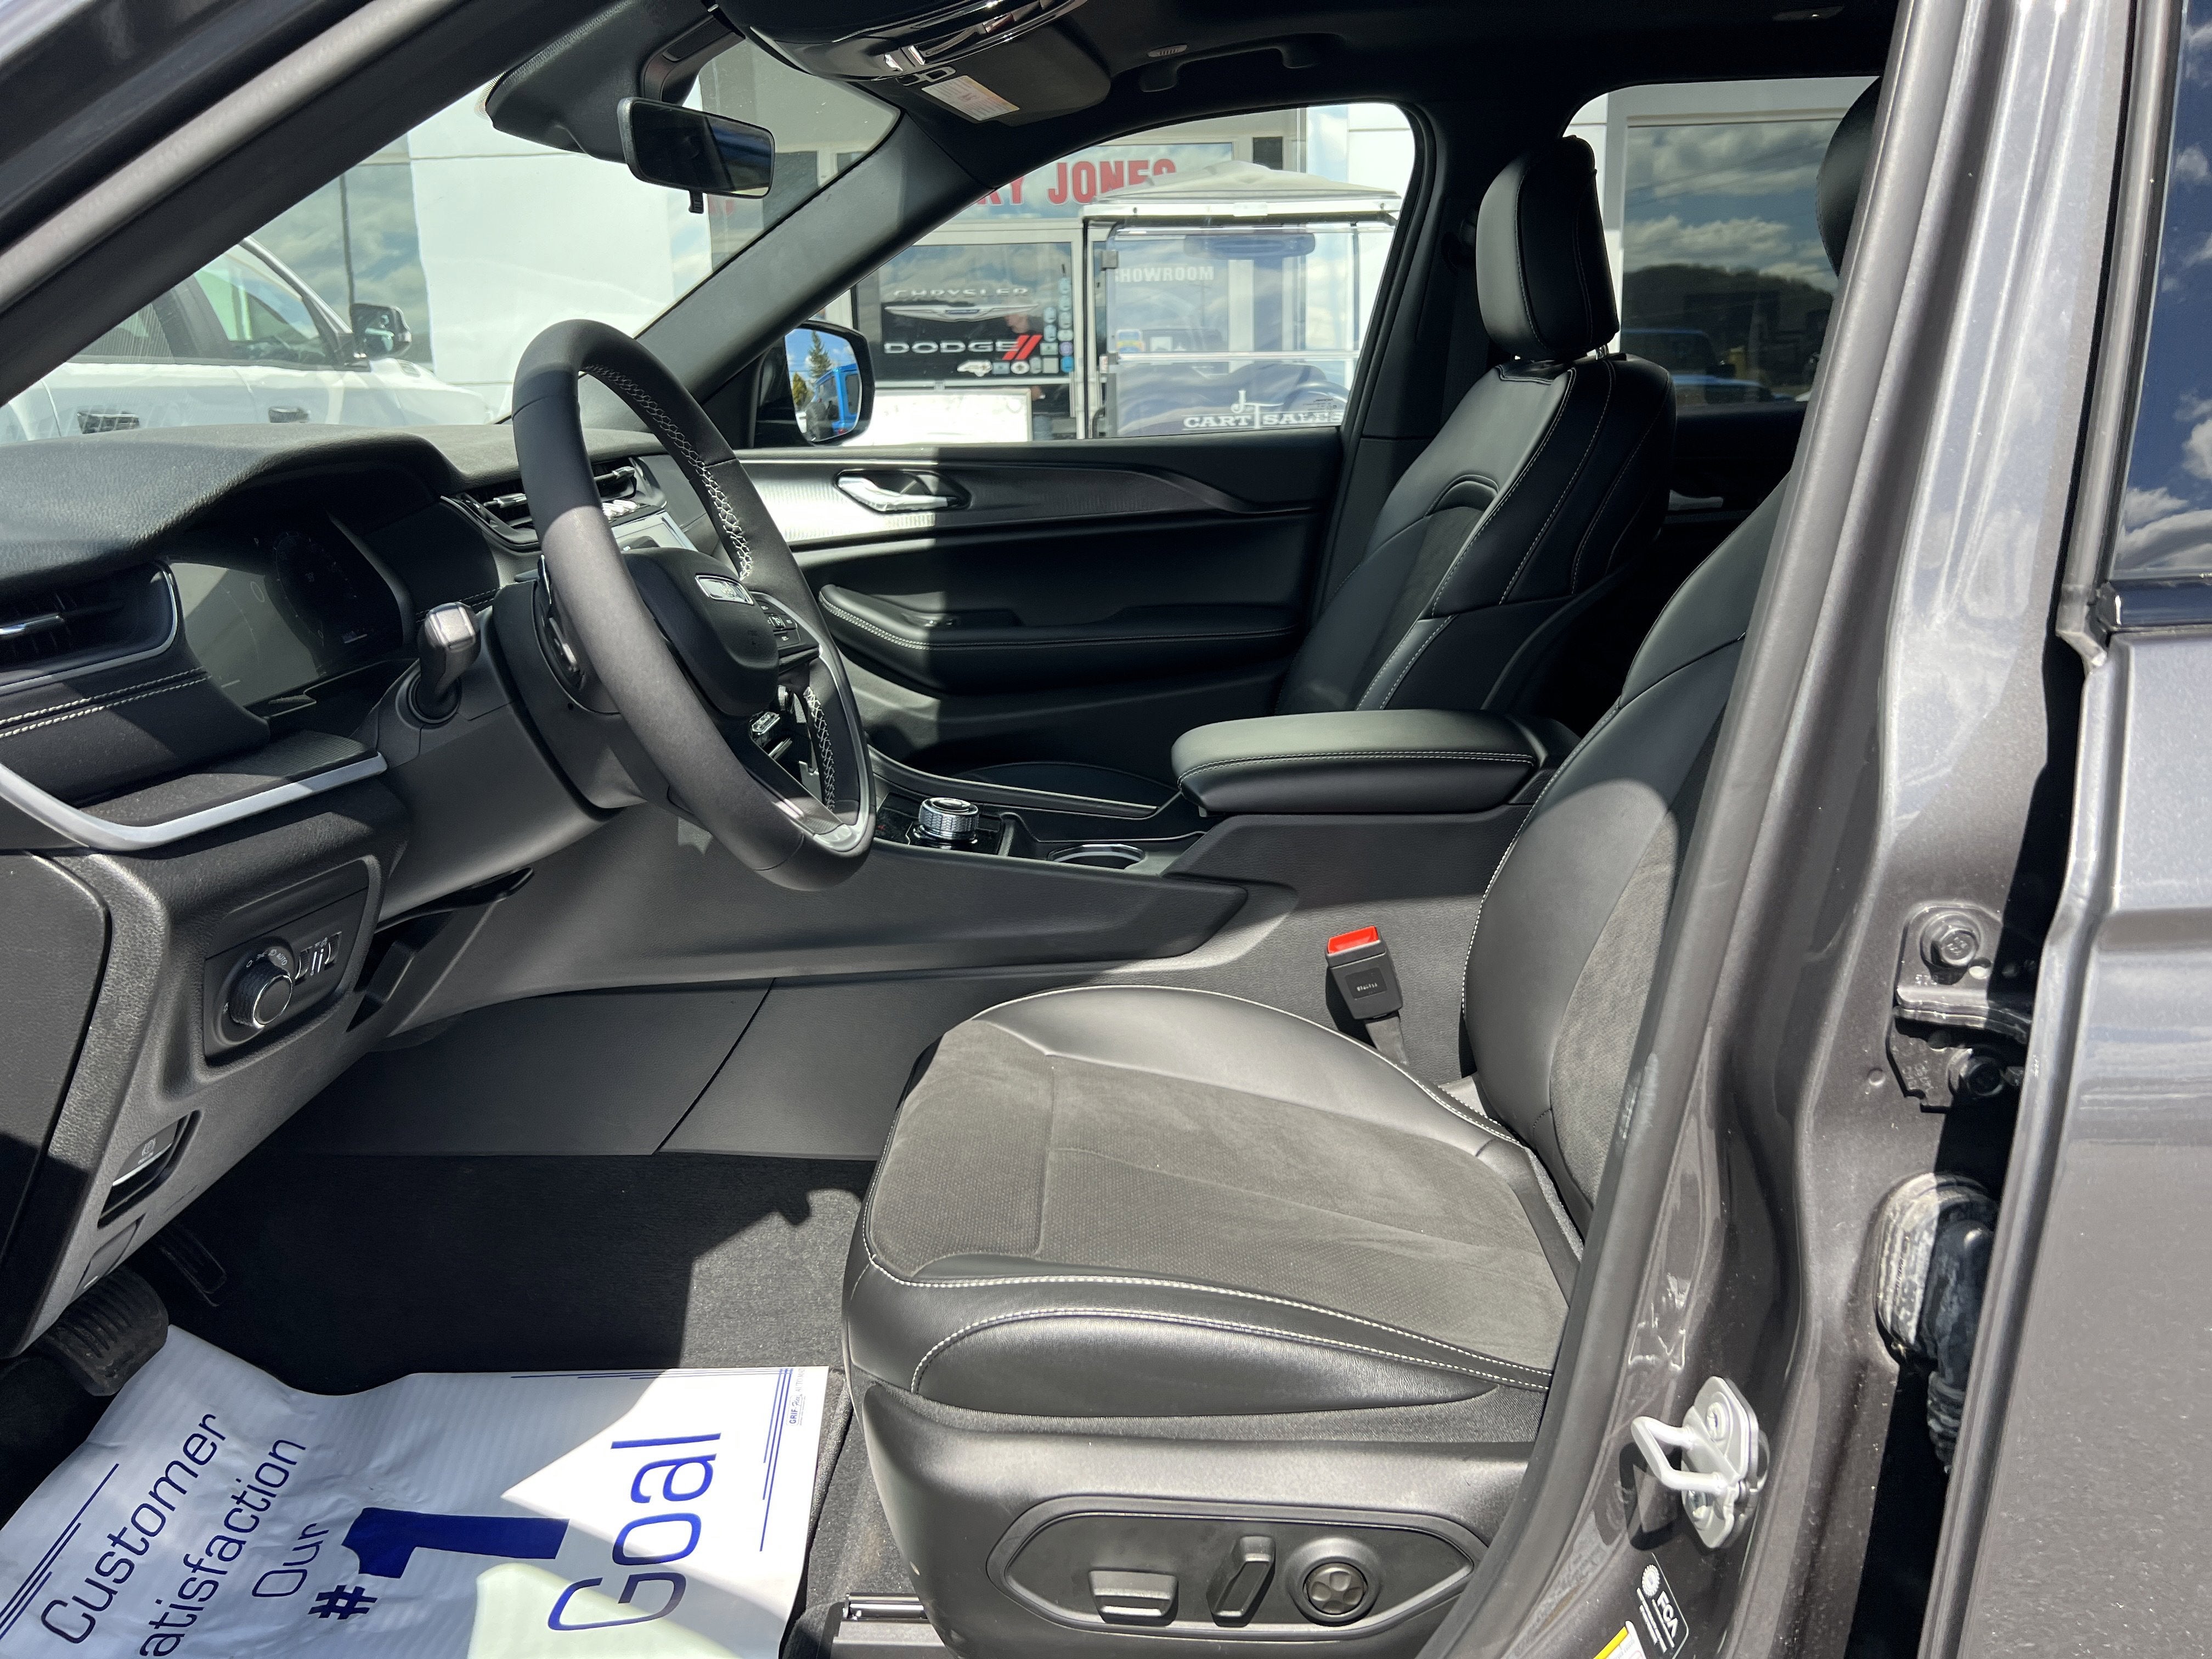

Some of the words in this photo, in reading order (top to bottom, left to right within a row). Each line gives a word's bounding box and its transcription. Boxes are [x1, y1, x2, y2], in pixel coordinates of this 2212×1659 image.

[883, 340, 1019, 354] DODGE
[1183, 415, 1252, 428] CART
[1262, 411, 1344, 426] SALES
[276, 953, 287, 966] AUTO
[41, 1413, 226, 1644] Customer
[548, 1432, 722, 1631] Goal
[252, 1523, 329, 1598] Our
